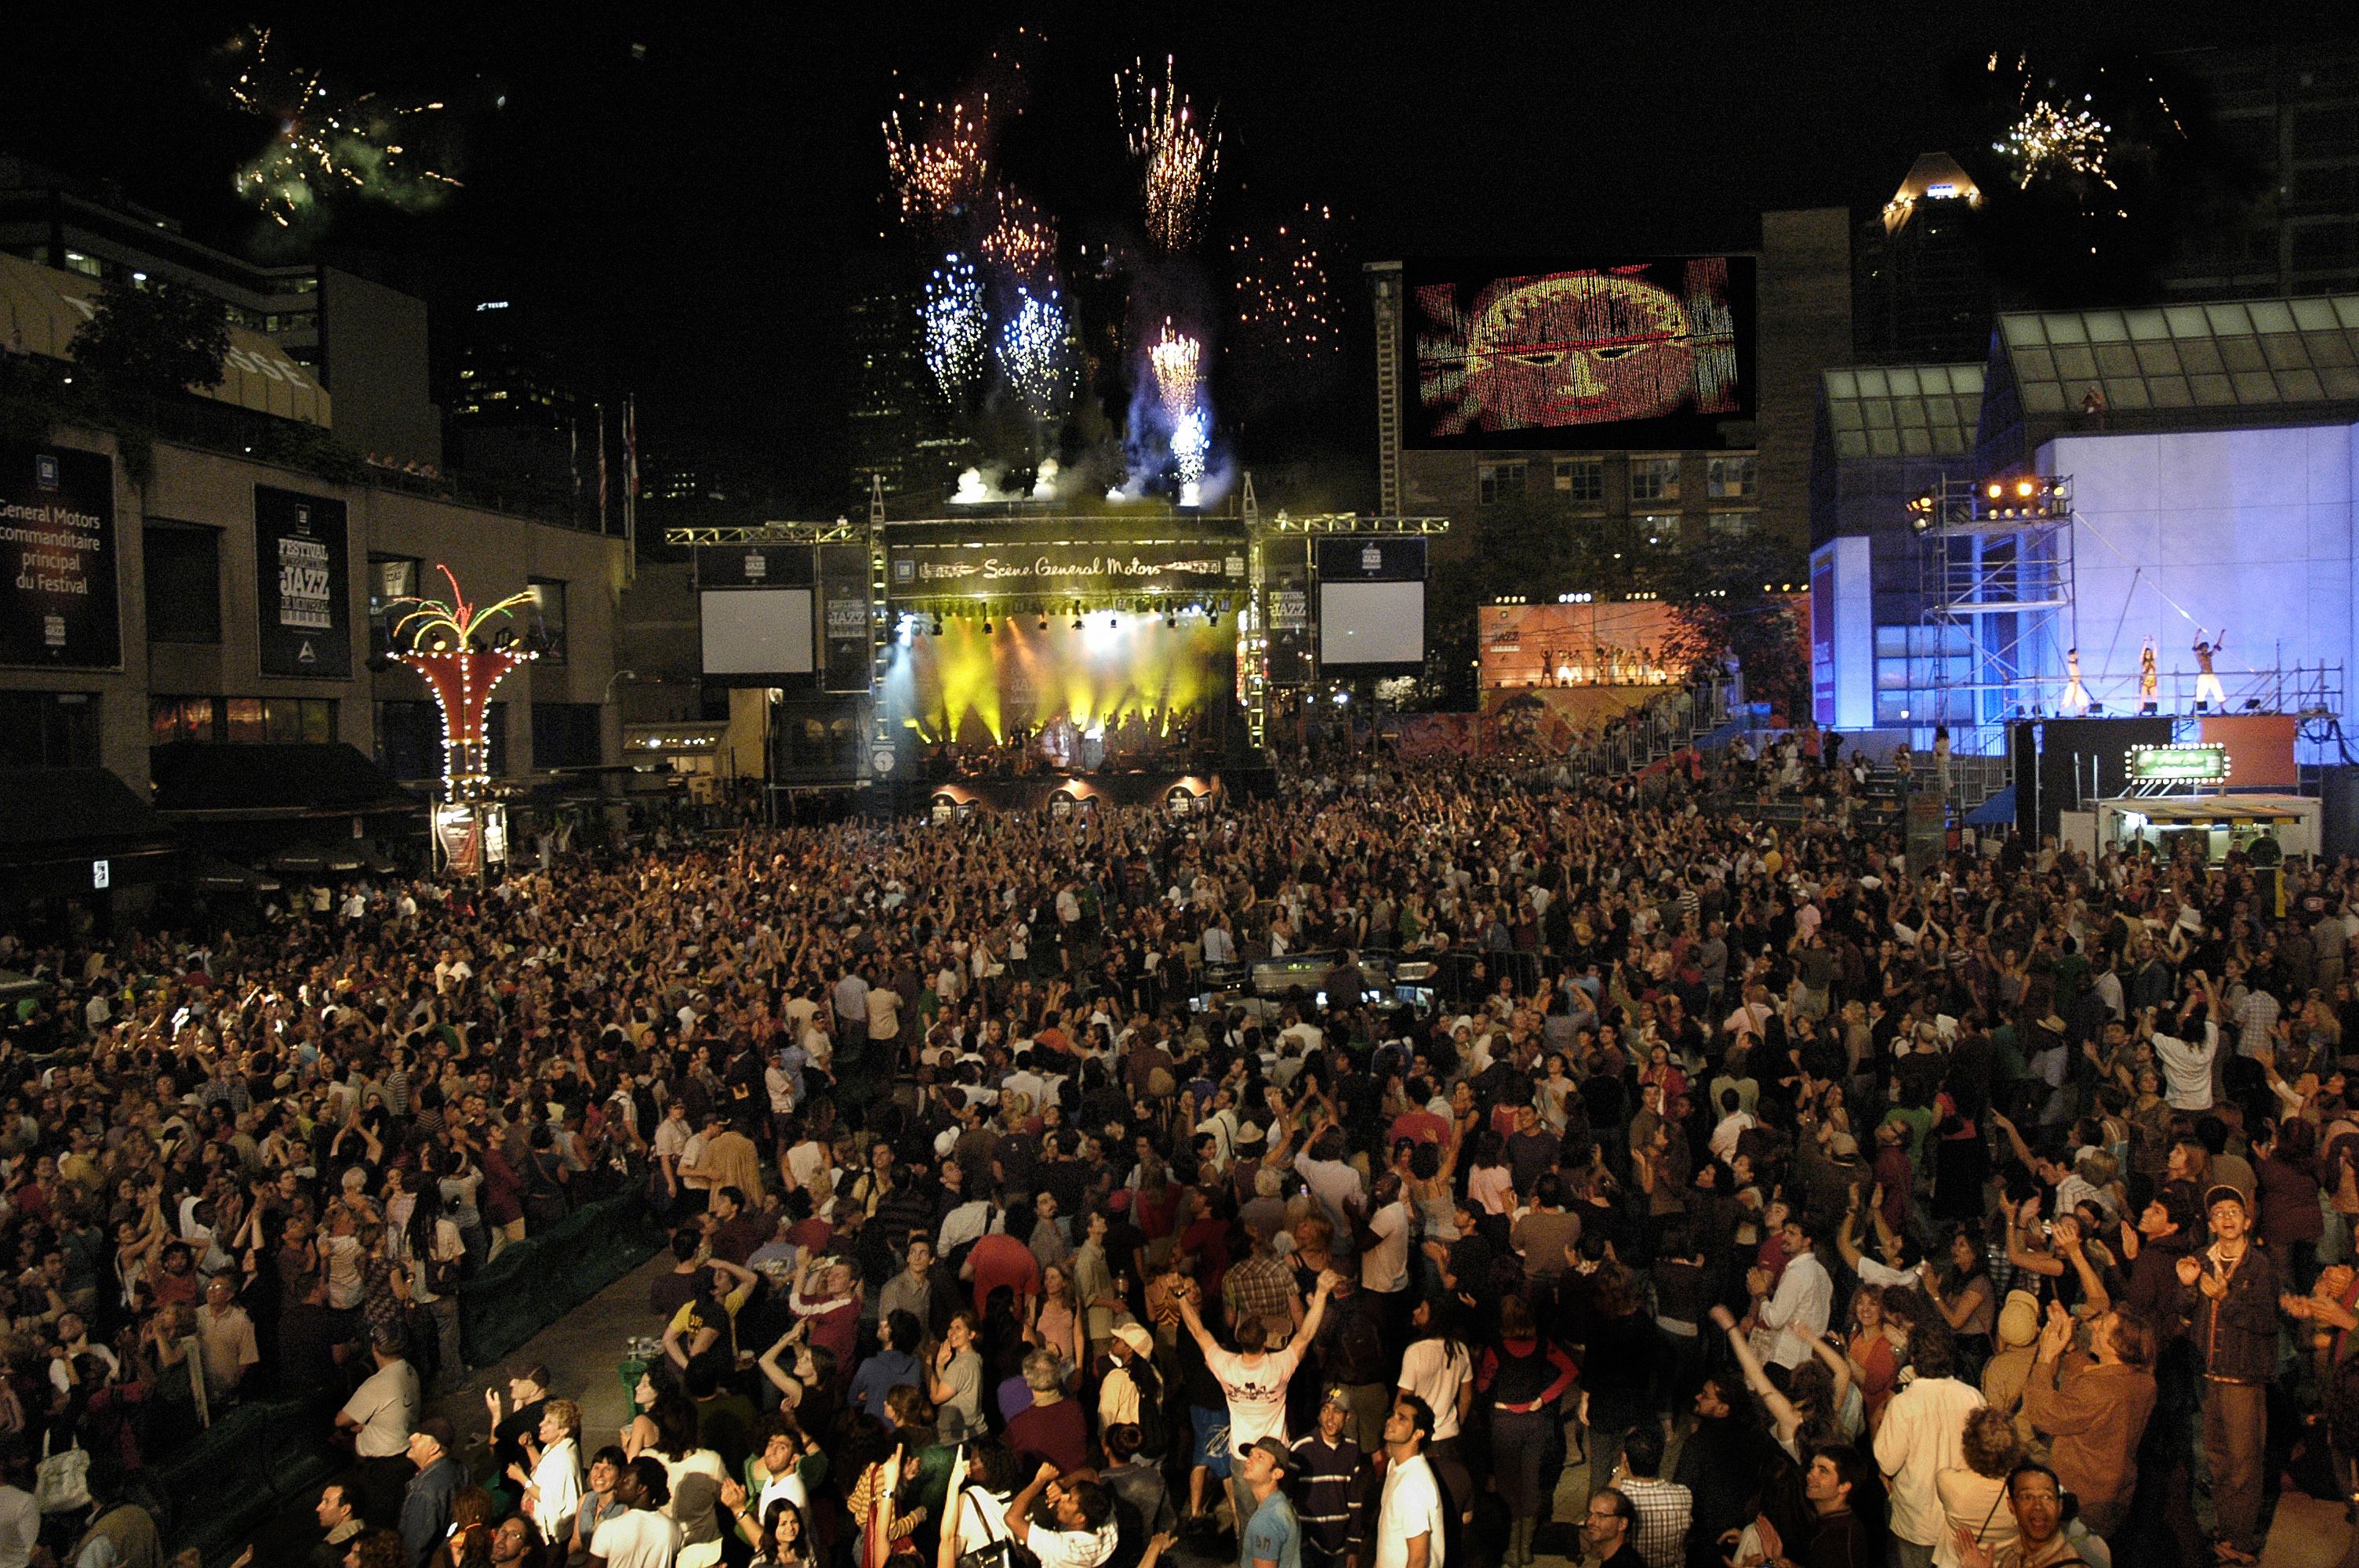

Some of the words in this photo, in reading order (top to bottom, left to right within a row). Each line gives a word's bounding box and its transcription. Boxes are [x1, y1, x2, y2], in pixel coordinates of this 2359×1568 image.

[53, 506, 100, 529] Motors
[0, 526, 100, 550] commanditaire
[278, 538, 329, 561] FESTIVAL
[22, 550, 81, 574] principal
[1035, 557, 1103, 576] General
[1107, 556, 1161, 576] Motors
[16, 572, 35, 589] du
[38, 573, 89, 594] Festival
[280, 567, 330, 601] JAZZ
[828, 610, 866, 625] JAZZ
[1269, 602, 1307, 617] JAZZ
